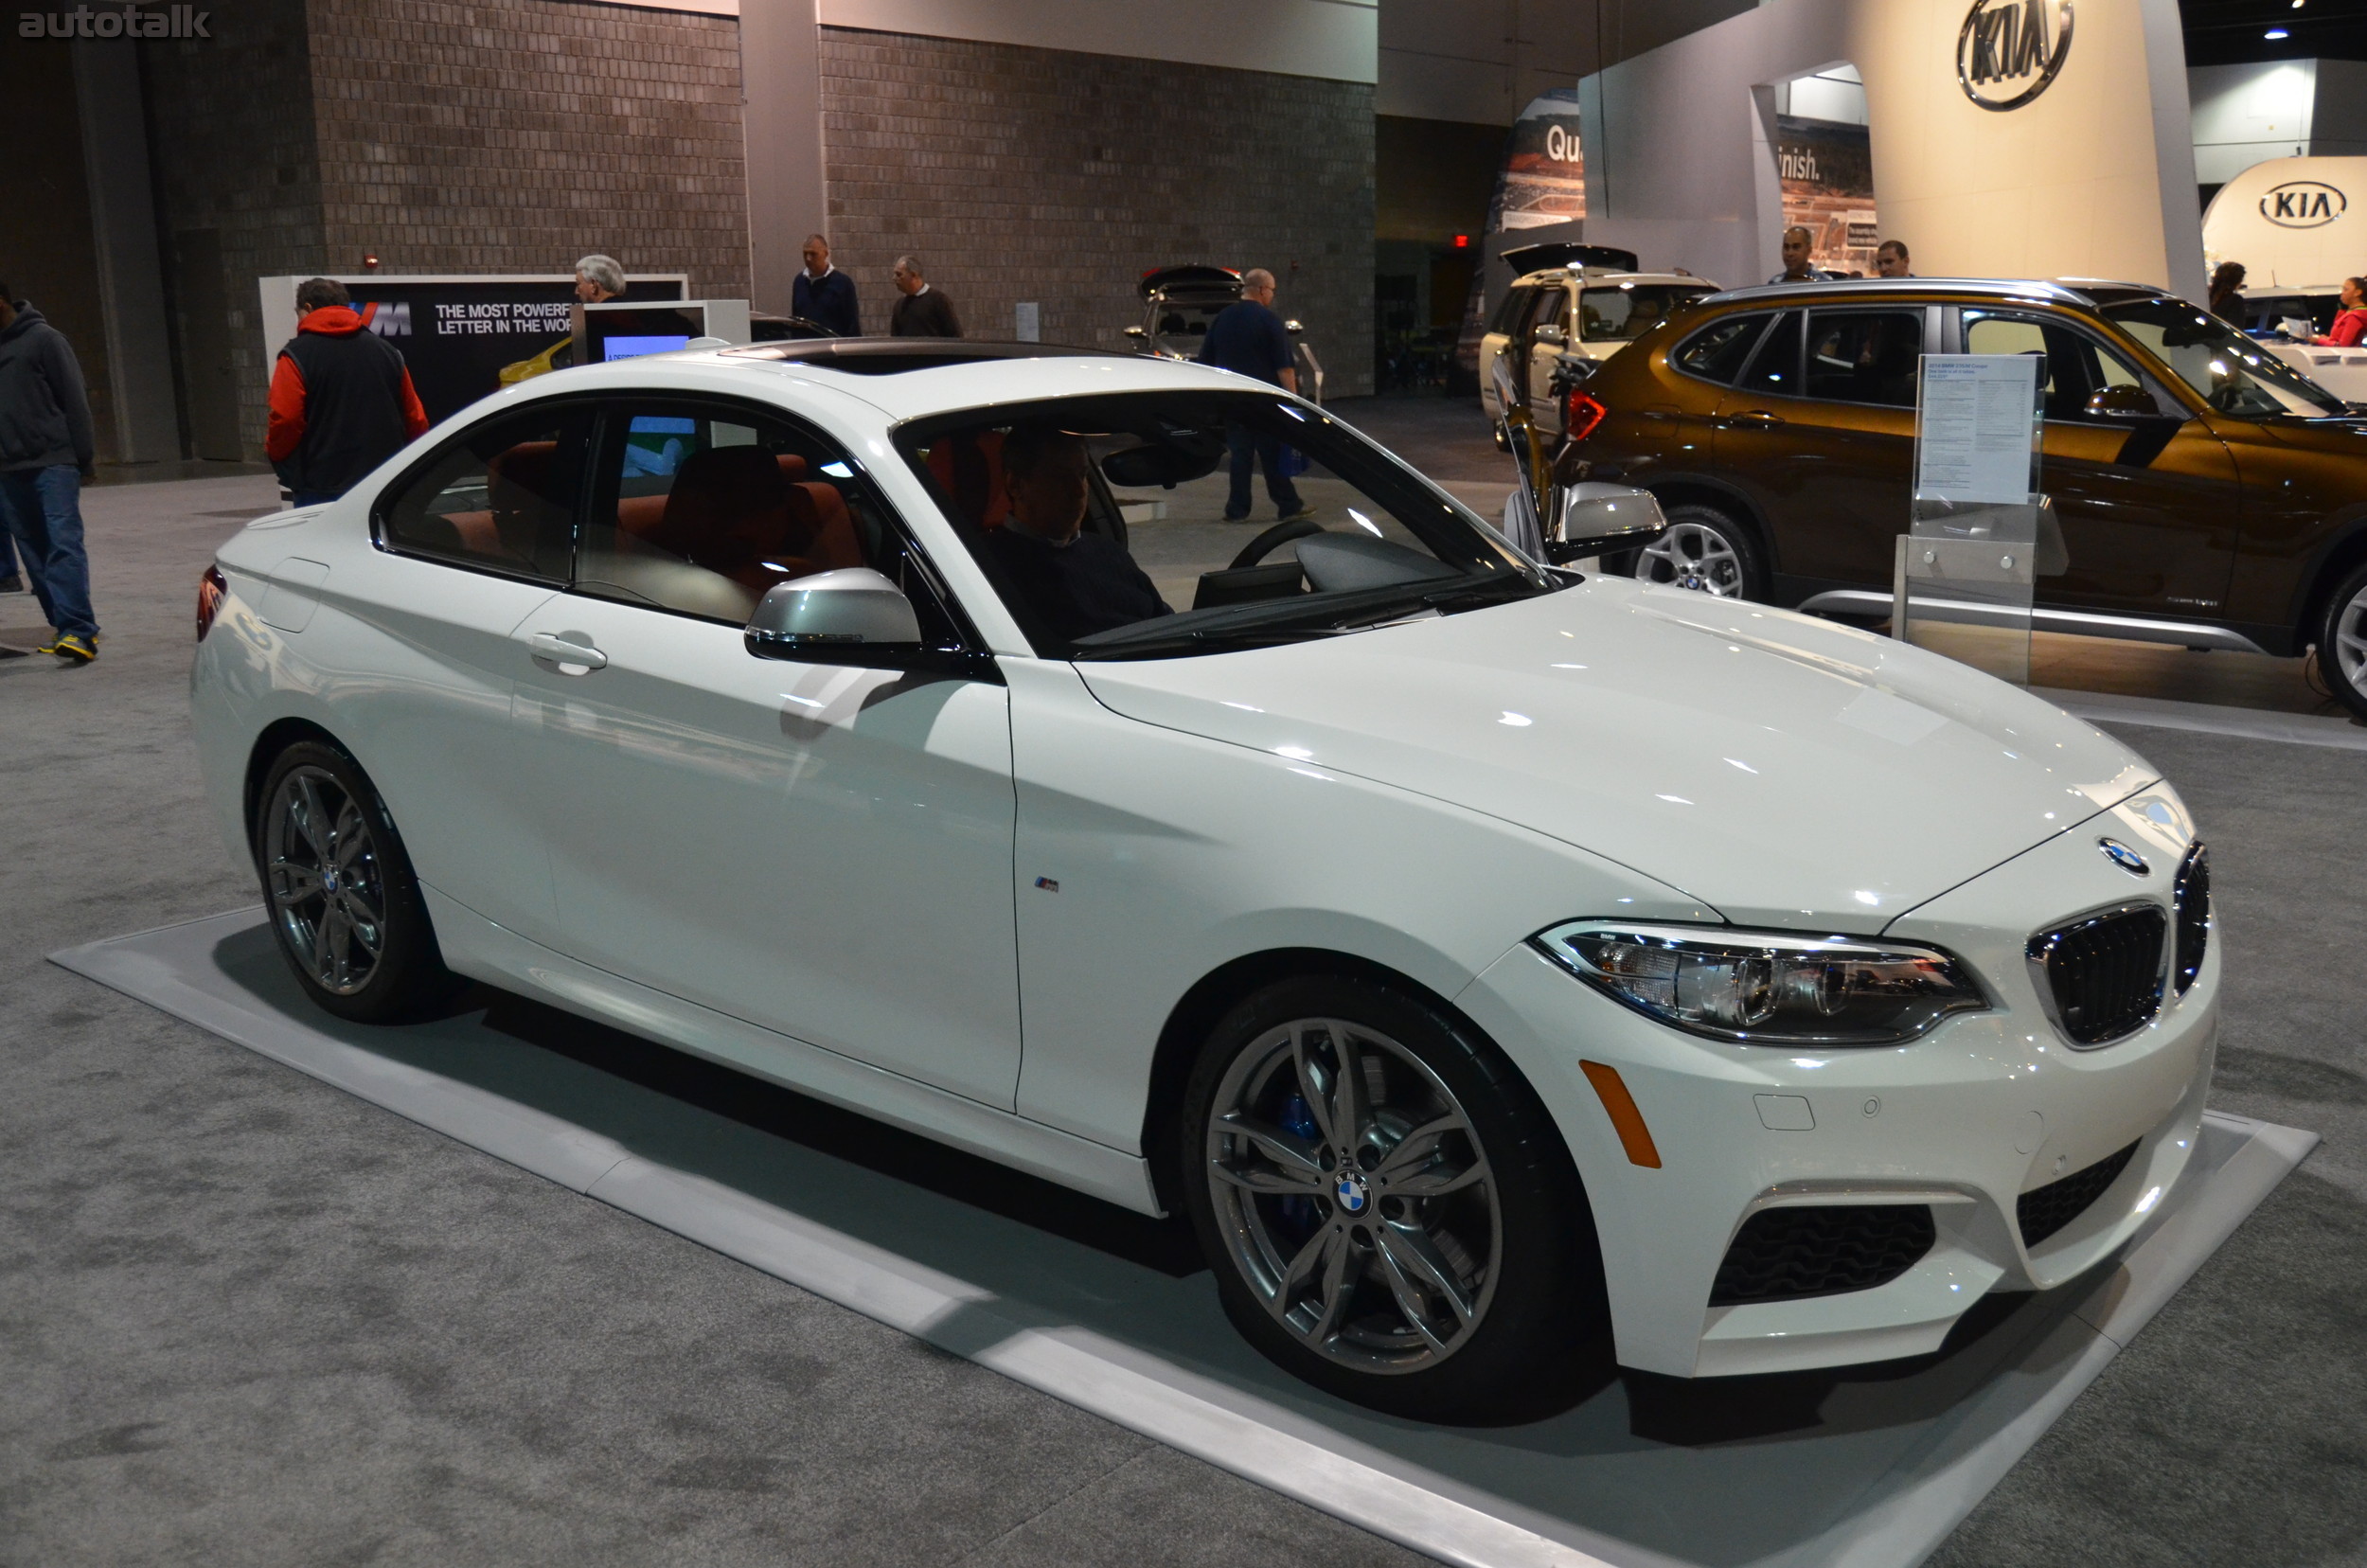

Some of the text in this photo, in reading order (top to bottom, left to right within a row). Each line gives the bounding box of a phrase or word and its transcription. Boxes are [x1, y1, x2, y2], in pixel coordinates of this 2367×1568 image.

[1971, 0, 2050, 85] KIA
[1547, 125, 1583, 162] Qu
[2274, 192, 2331, 218] KIA
[436, 303, 582, 318] THE MOST POWERF
[437, 319, 493, 334] LETTER
[495, 319, 510, 333] IN
[513, 318, 542, 332] THE
[1334, 1172, 1369, 1191] BMW
